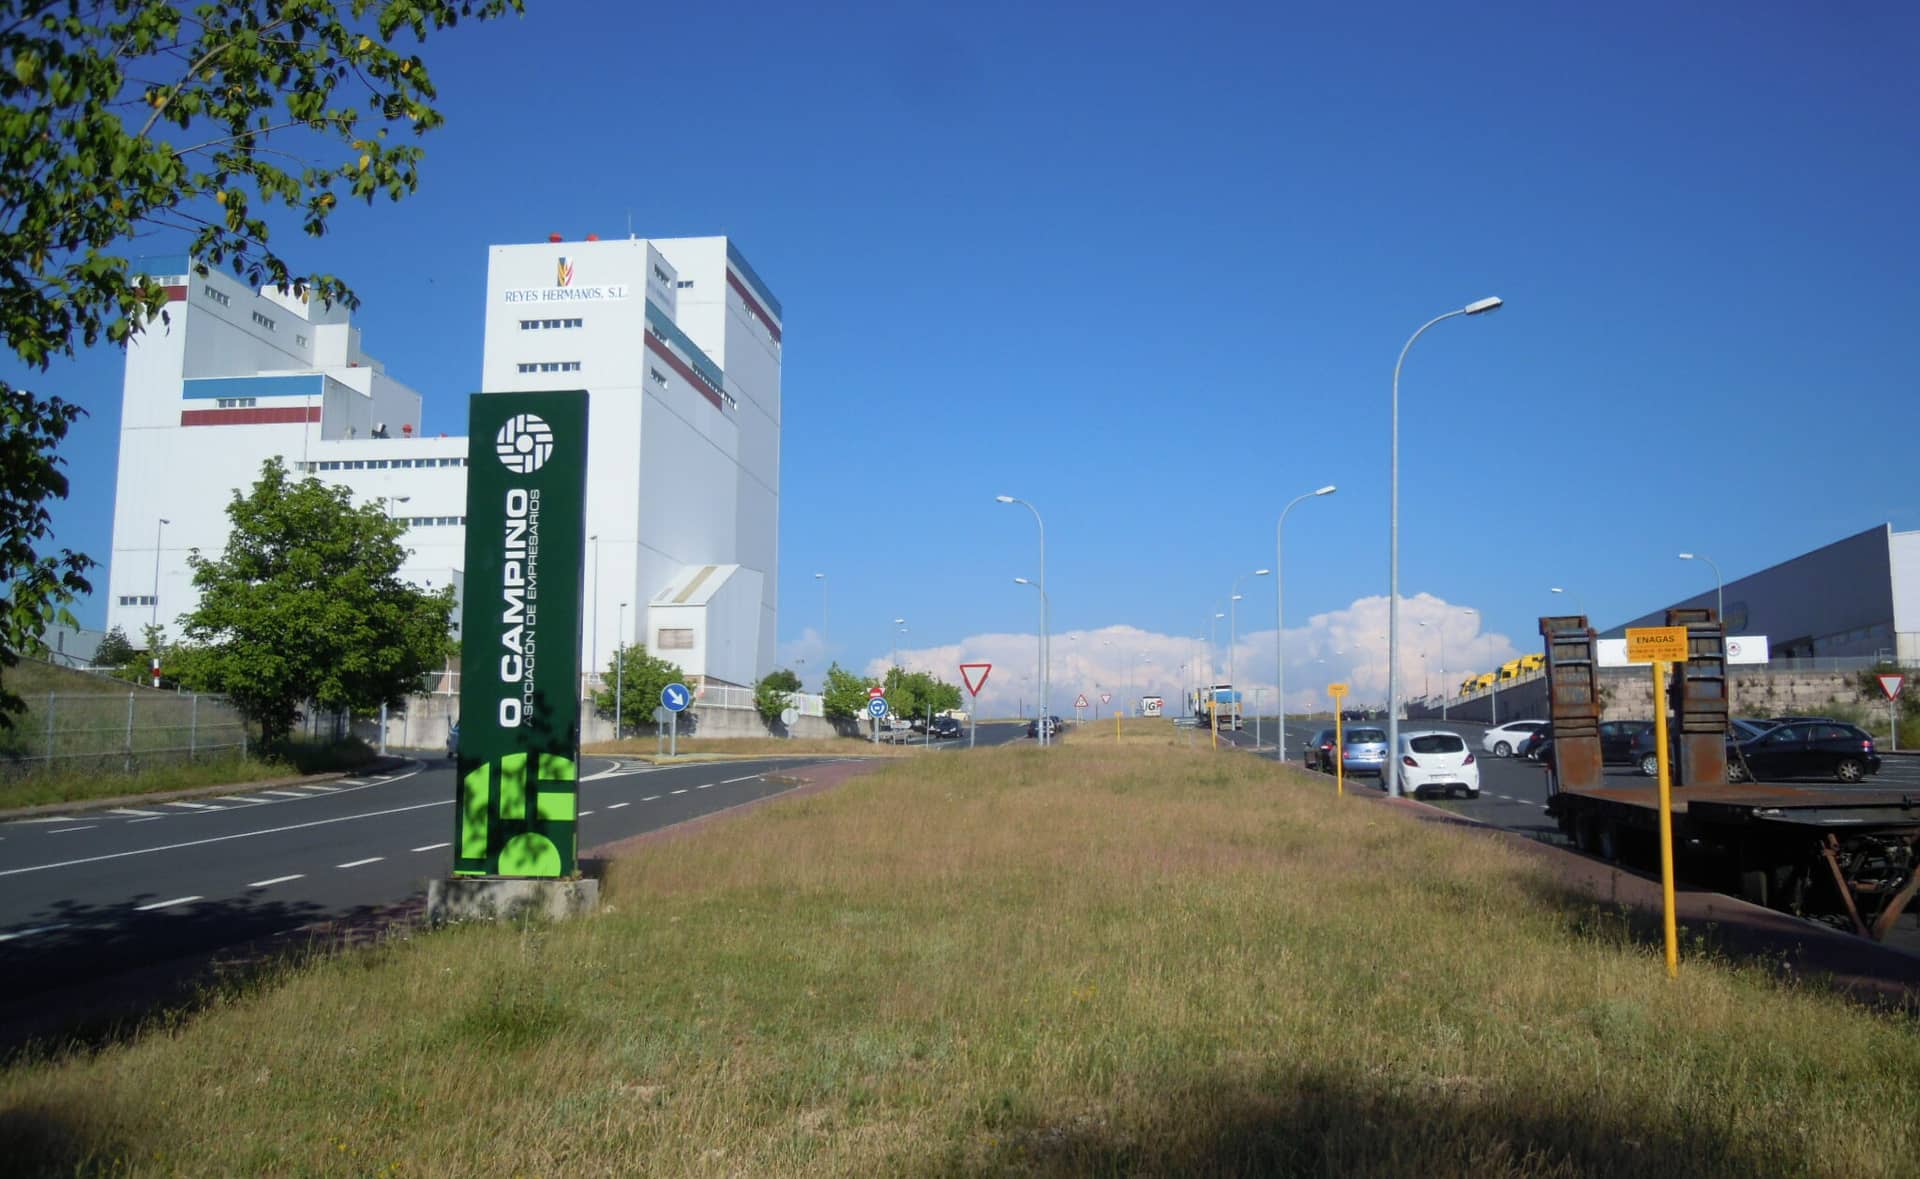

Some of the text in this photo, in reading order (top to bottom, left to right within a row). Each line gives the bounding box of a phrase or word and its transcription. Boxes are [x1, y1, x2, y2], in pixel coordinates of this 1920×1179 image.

[505, 290, 538, 302] REYES
[527, 489, 541, 600] EMPRESARIOS
[526, 604, 537, 625] DE
[1636, 635, 1675, 644] ENAGAS
[500, 697, 522, 728] O
